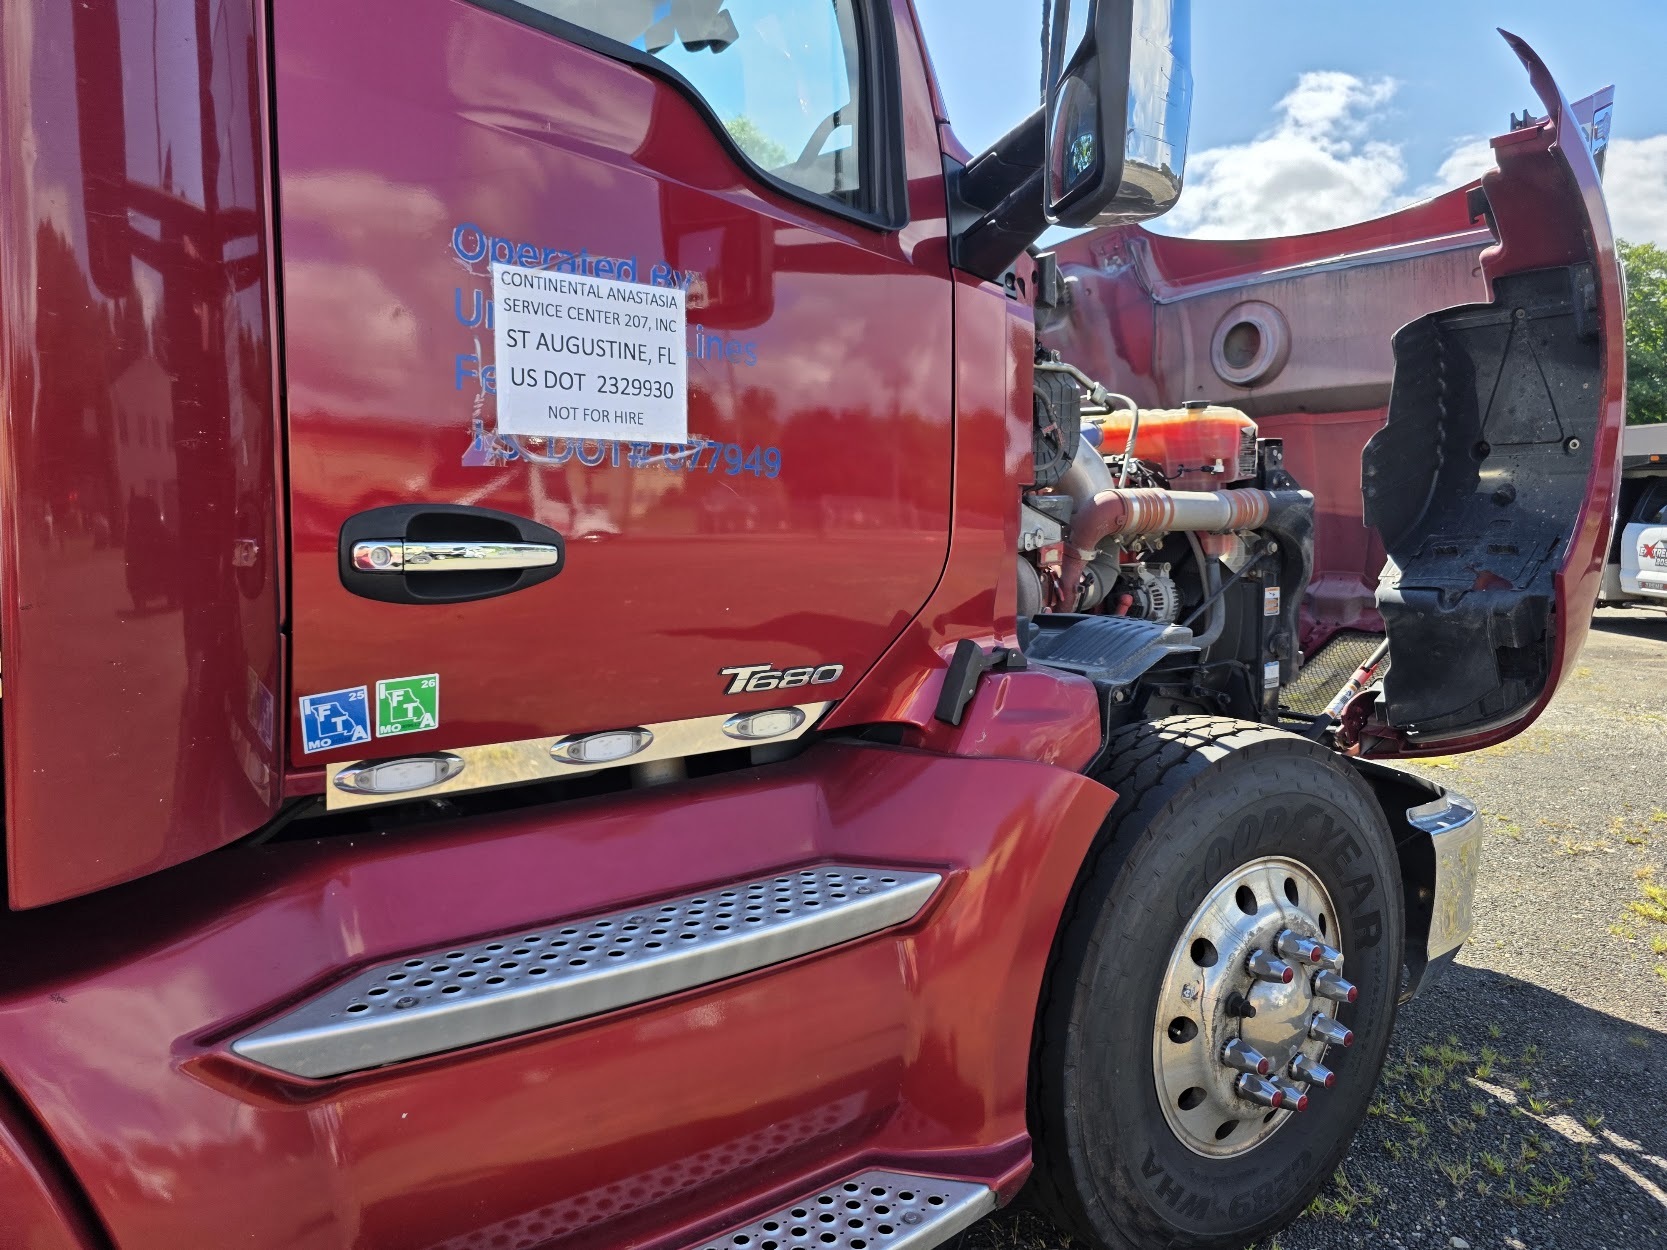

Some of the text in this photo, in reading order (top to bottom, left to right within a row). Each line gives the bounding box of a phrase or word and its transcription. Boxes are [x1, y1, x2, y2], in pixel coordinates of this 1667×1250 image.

[501, 271, 678, 309] CONTINENTAL ANASTASIA
[503, 298, 562, 318] SERVICE
[567, 306, 620, 325] CENTER
[625, 313, 651, 332] 207,
[656, 318, 677, 333] INC
[506, 329, 676, 366] ST AUGUSTINE, FL
[687, 324, 758, 366] ines
[511, 367, 538, 387] US
[544, 370, 586, 391] DOT
[597, 375, 674, 399] 2329930
[548, 405, 644, 425] NOT FOR HIRE
[1639, 543, 1667, 559] EXTRE
[420, 679, 436, 688] 26
[717, 662, 844, 695] T680
[348, 691, 364, 701] 25
[380, 723, 401, 734] MO
[308, 738, 331, 750] MO
